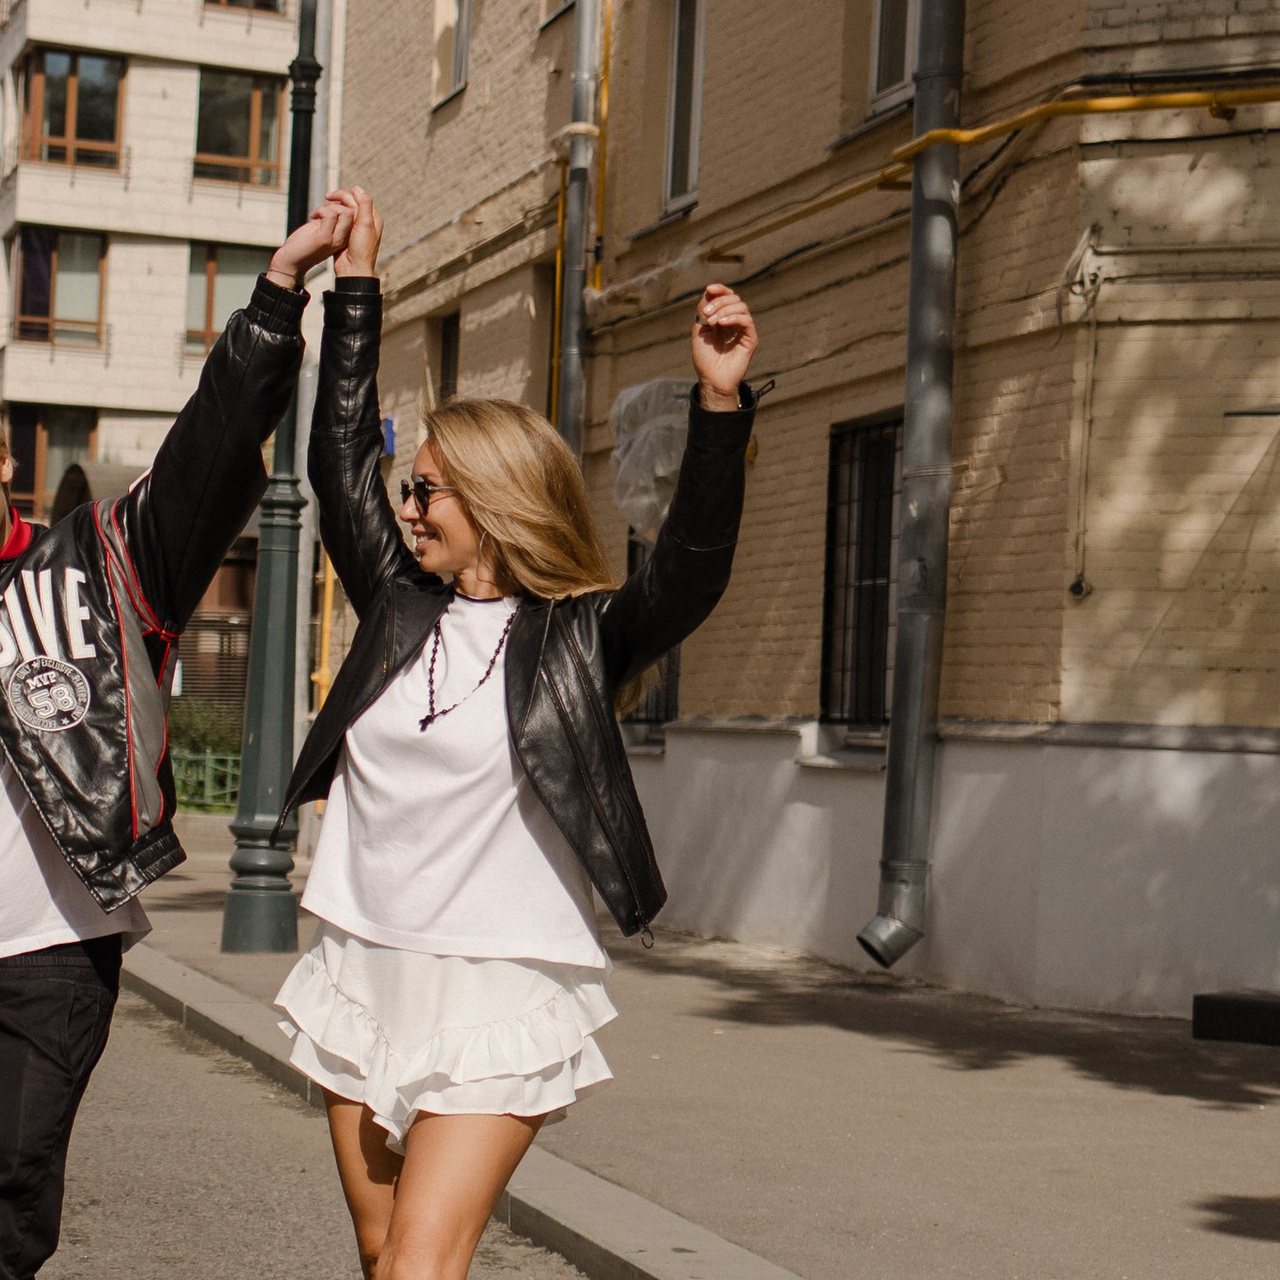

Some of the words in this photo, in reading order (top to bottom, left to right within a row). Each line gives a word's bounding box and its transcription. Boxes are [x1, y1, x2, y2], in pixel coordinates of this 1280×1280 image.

[16, 664, 32, 680] ONLY
[41, 658, 74, 677] EXCLUSIVE
[26, 670, 57, 691] MVP
[27, 683, 77, 720] 58
